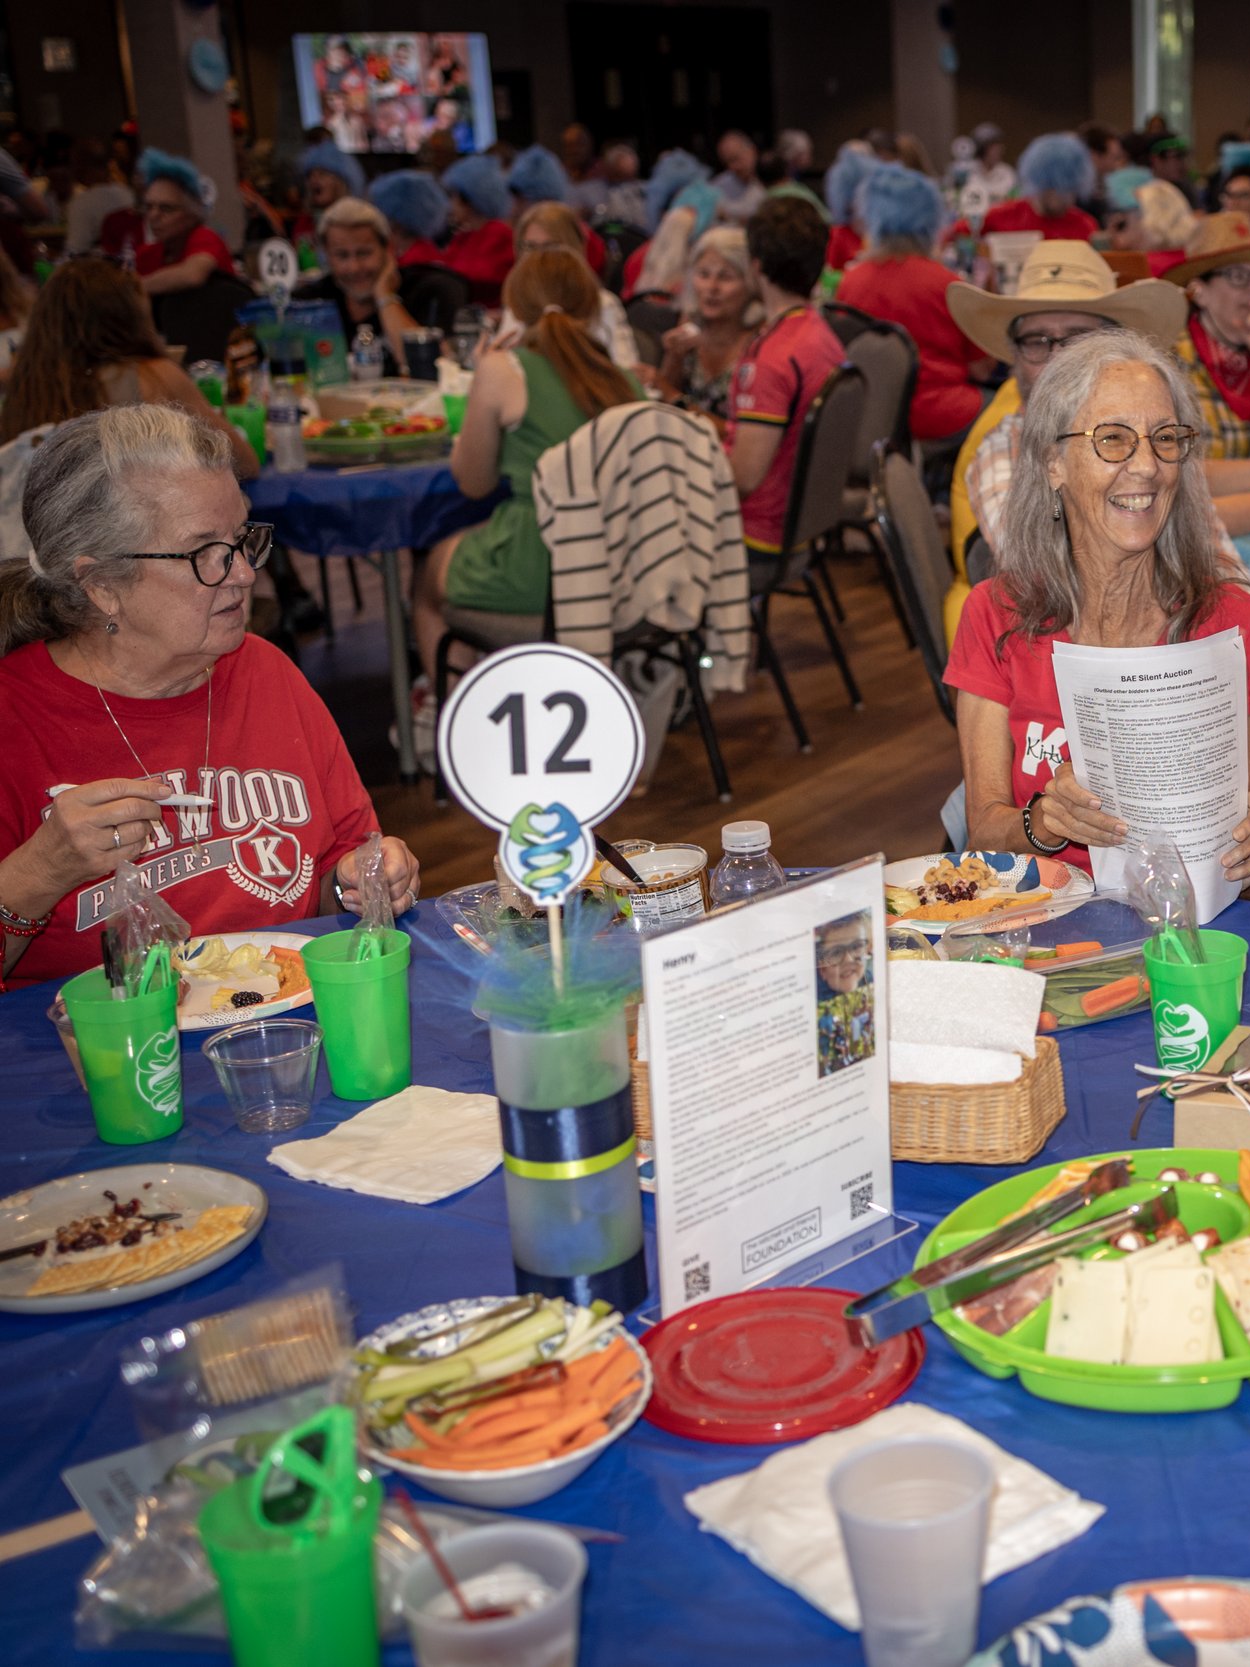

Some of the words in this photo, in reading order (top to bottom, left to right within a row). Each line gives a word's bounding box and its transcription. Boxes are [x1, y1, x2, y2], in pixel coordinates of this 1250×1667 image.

[267, 249, 290, 277] 20
[1120, 674, 1137, 682] BAE
[1138, 674, 1162, 682] Silent
[1163, 668, 1193, 679] Auction
[487, 690, 591, 776] 12
[142, 769, 310, 854] WOOD
[249, 836, 291, 877] K
[92, 848, 211, 919] PNEERS
[746, 1222, 818, 1267] FOUNDATION
